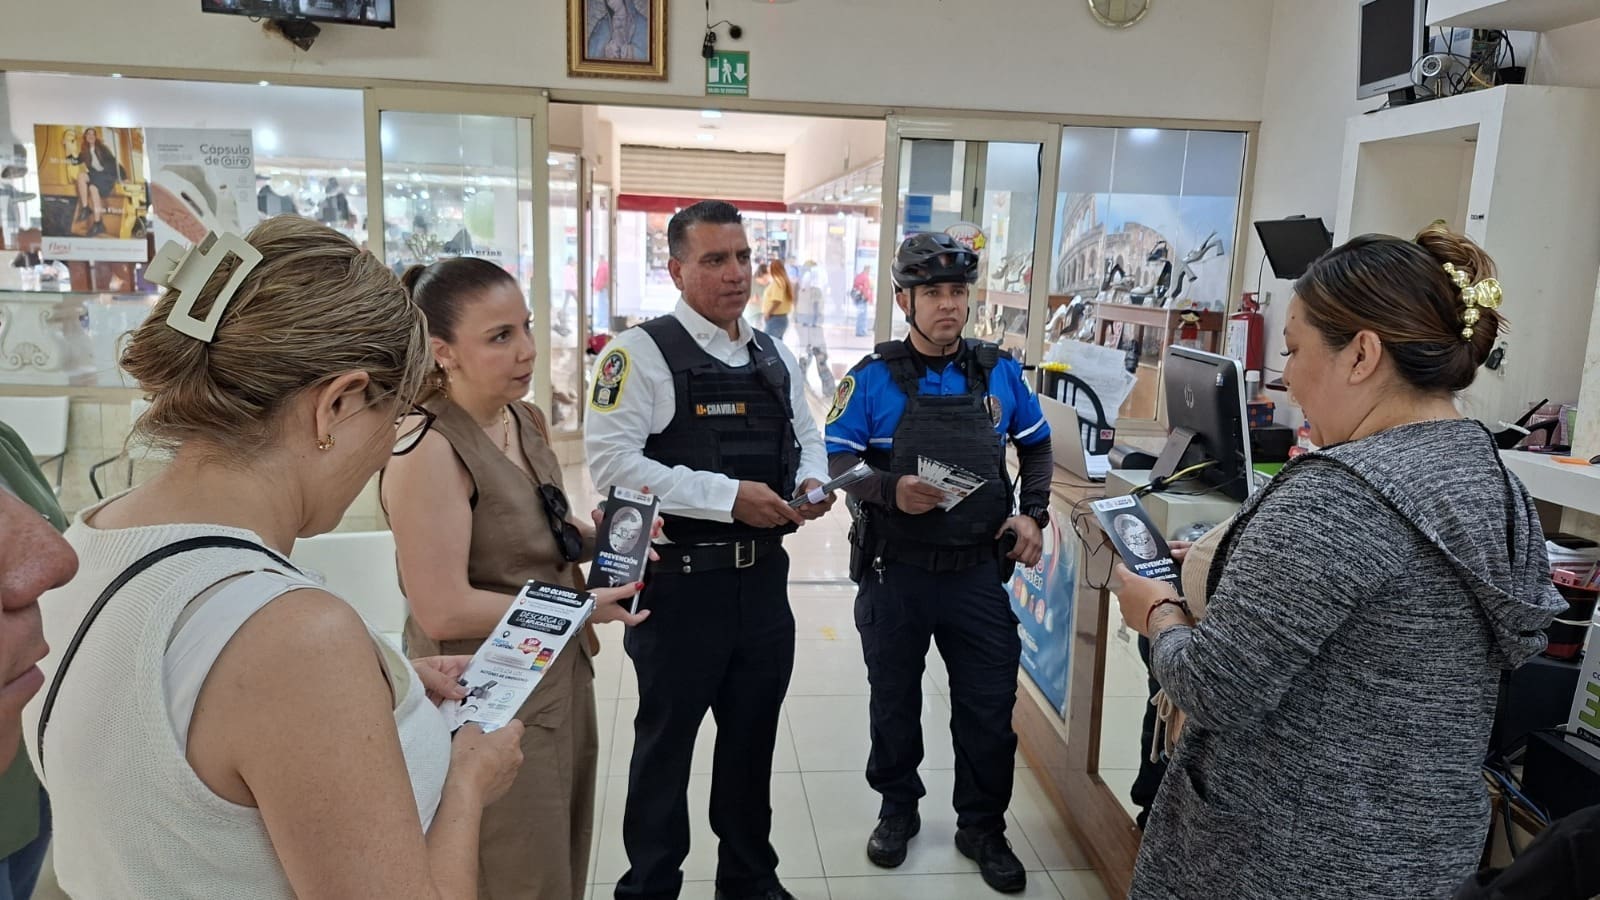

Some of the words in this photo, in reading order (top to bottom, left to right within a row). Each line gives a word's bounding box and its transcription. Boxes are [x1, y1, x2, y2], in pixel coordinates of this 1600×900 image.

[200, 143, 250, 156] Cápsula
[204, 155, 219, 166] de
[223, 156, 249, 167] aire
[599, 551, 638, 566] PREVENCIÓN
[1134, 557, 1174, 571] PREVENCIÓN
[550, 588, 579, 599] OLVIDES
[520, 610, 557, 624] DESCARGA
[525, 618, 562, 631] APLICACIONES
